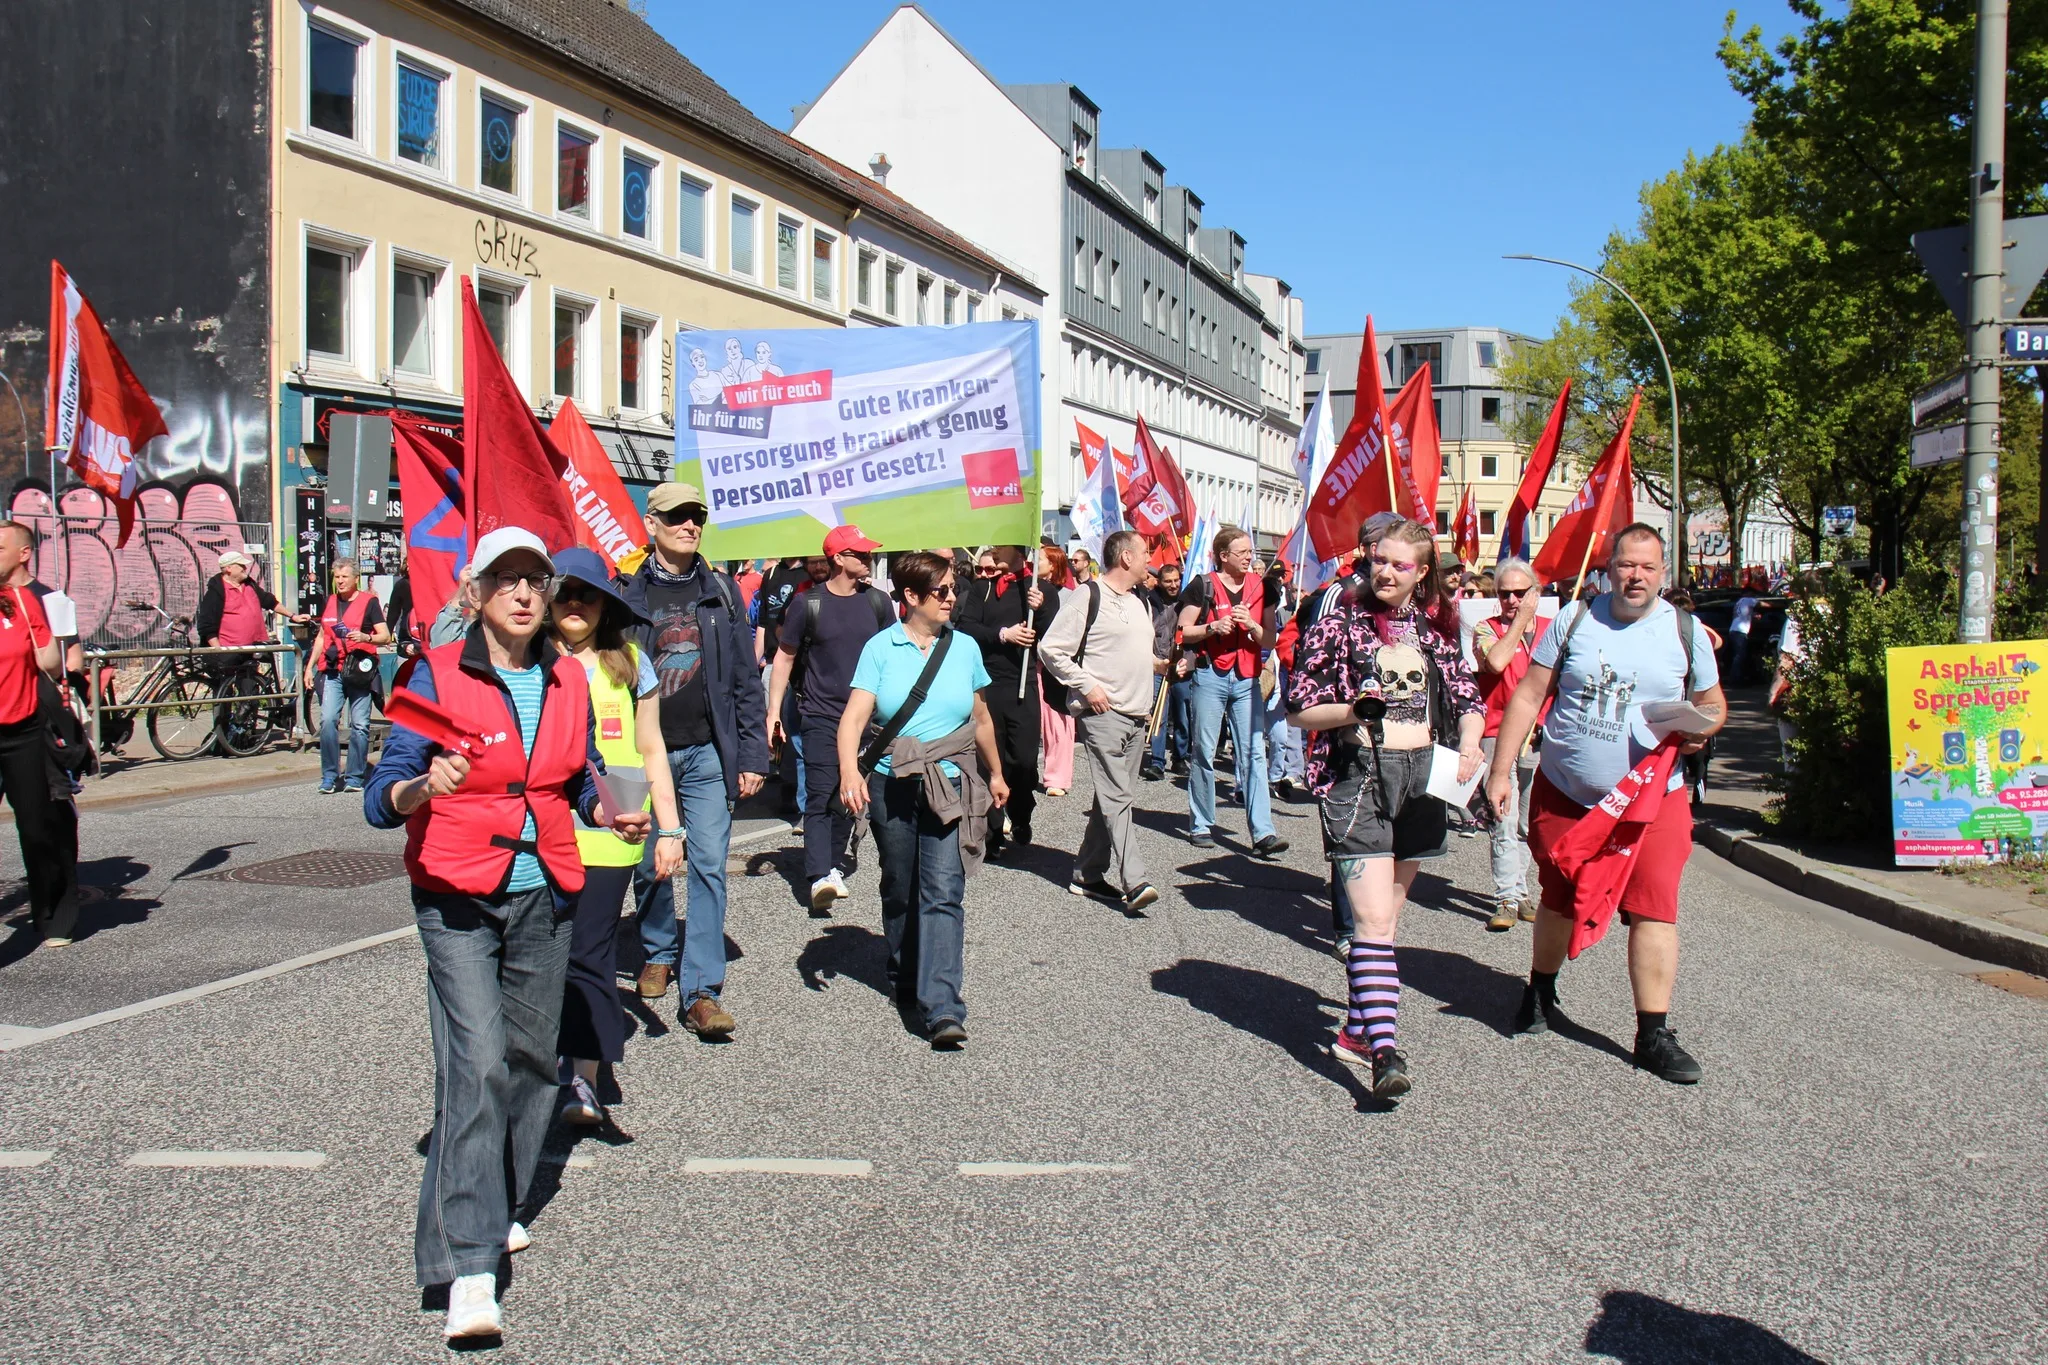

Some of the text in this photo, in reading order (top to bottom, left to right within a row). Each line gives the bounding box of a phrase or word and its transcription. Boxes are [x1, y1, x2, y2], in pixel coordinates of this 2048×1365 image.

[2016, 331, 2048, 351] Ba
[735, 380, 822, 405] wir für euch
[838, 374, 999, 421] Gute Kranken-
[692, 409, 764, 431] ihr für uns
[707, 404, 1009, 477] versorgung braucht genug
[712, 448, 947, 511] Personal per Gesetz!
[971, 480, 1019, 498] ver.di
[1577, 713, 1624, 732] NO JUSTICE
[1576, 724, 1619, 743] NO PEACE
[1904, 800, 1924, 808] Musik
